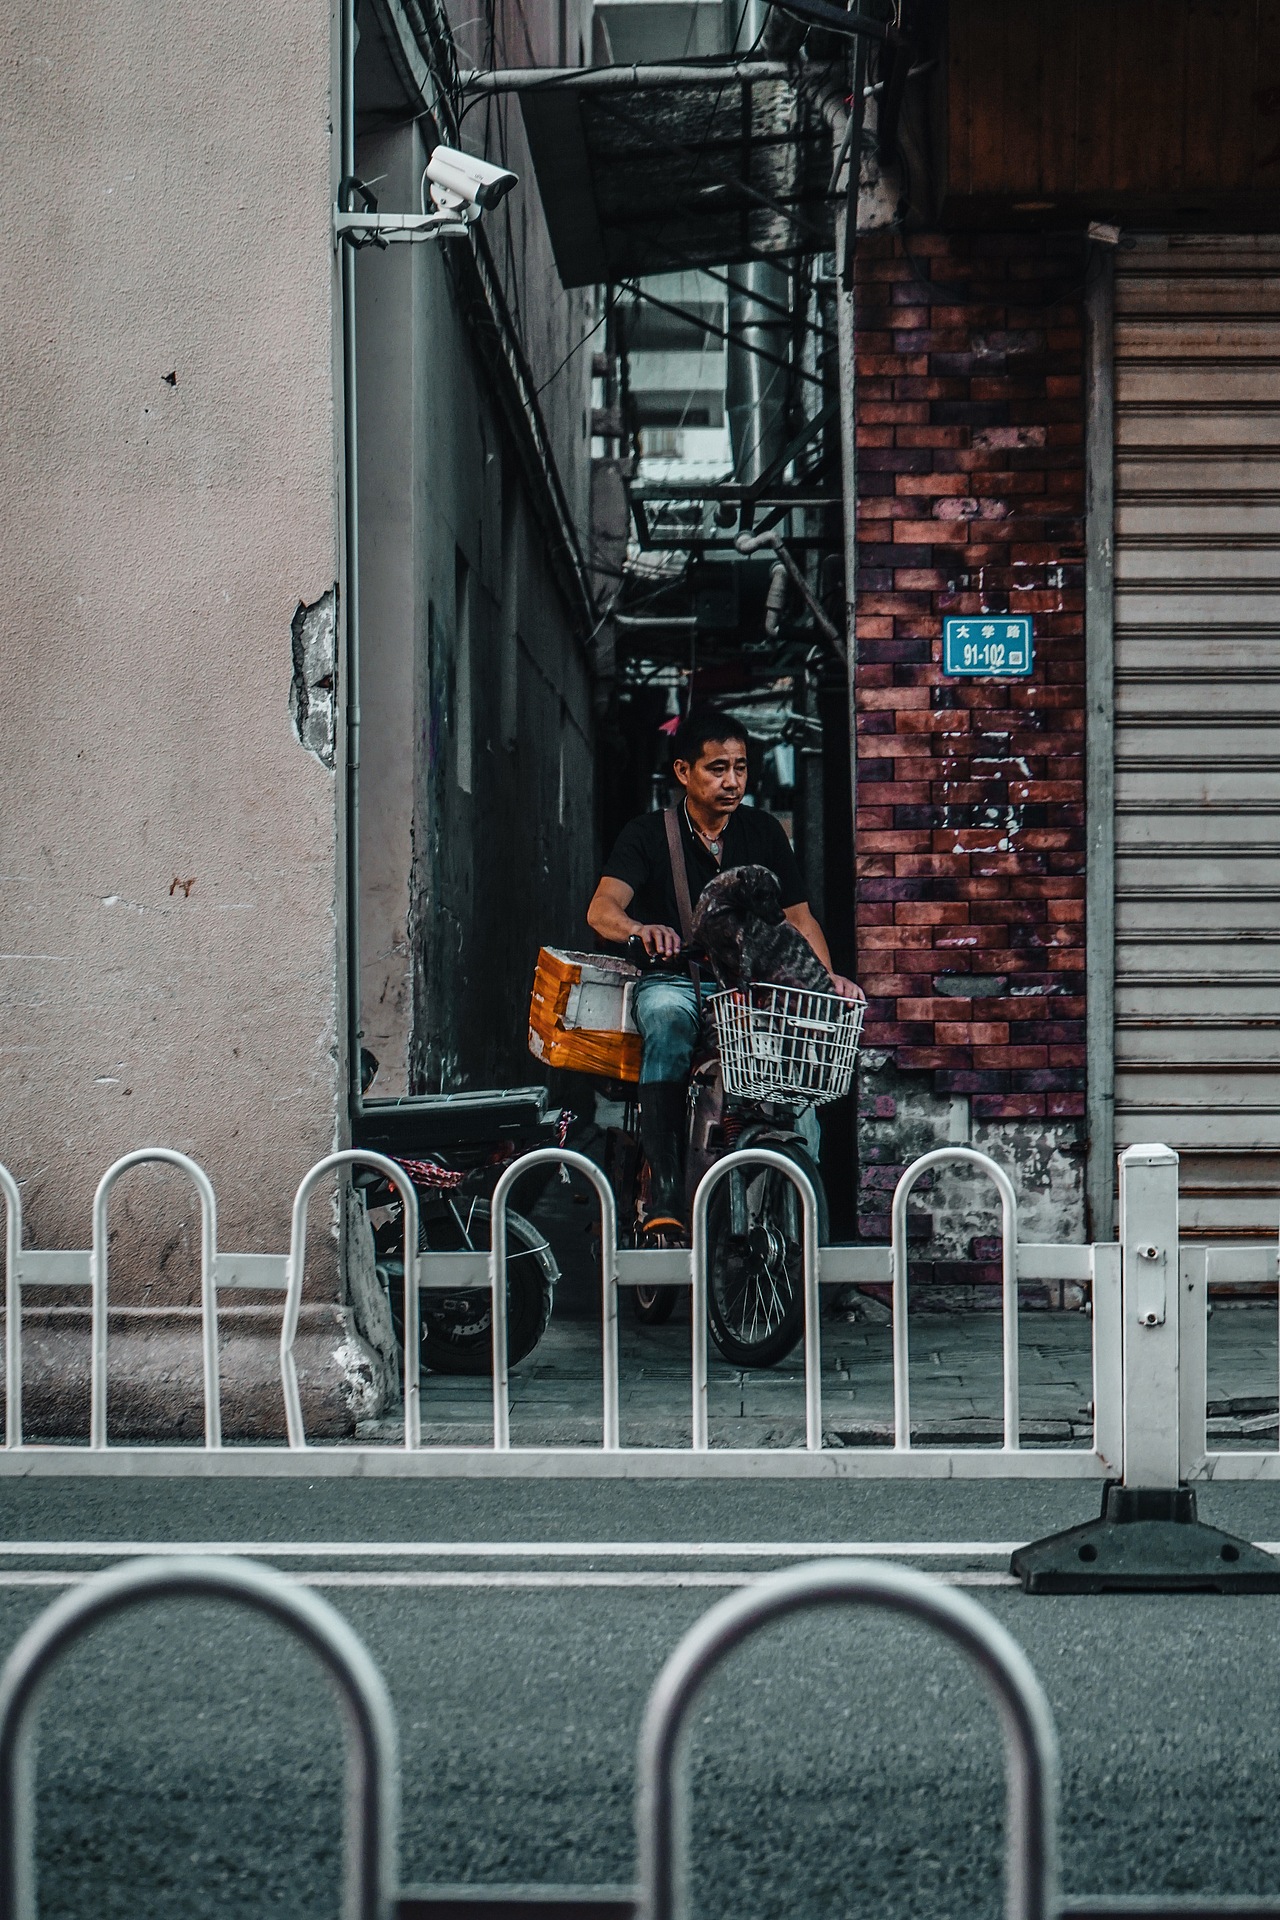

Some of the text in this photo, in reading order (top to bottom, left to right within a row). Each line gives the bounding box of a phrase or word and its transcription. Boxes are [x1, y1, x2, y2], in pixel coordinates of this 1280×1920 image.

[956, 624, 1020, 639] 大学路
[963, 643, 1005, 667] 91-102
